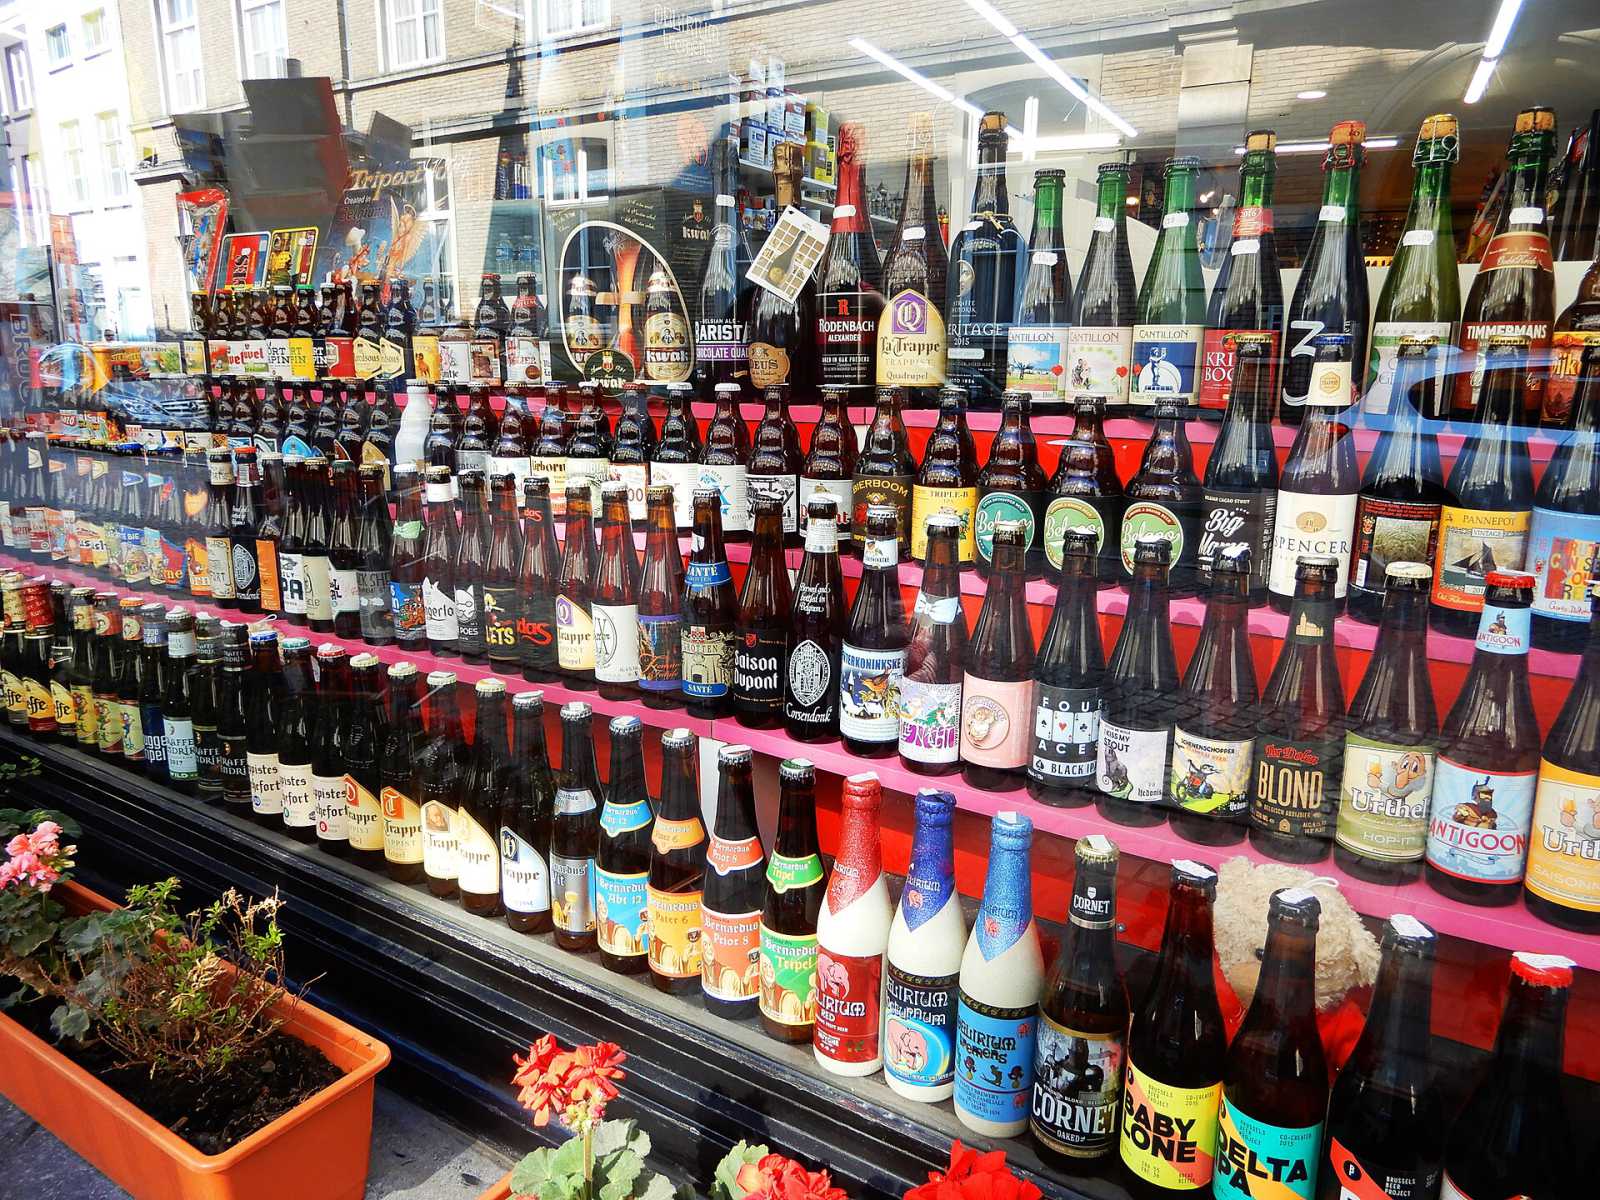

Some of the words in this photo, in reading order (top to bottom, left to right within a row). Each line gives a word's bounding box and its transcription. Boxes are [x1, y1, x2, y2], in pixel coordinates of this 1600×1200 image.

[837, 298, 850, 316] R
[818, 318, 875, 333] RODENBACH
[1139, 330, 1189, 339] CANTILLON
[954, 338, 970, 346] 2015
[852, 479, 908, 497] BIERBOOM
[1204, 508, 1245, 538] Big
[1463, 514, 1516, 526] PANNEPOT
[1275, 535, 1350, 554] SPENCER
[1478, 633, 1521, 648] ANTIGOON
[734, 650, 778, 672] Saison
[734, 669, 779, 692] Dupont
[786, 702, 833, 722] Corsendonk
[1103, 737, 1131, 754] STOUT
[1051, 762, 1083, 776] BLACK
[1257, 760, 1324, 809] BLOND
[1351, 787, 1429, 819] Urthel
[1430, 818, 1527, 854] ANTIGOON
[1072, 894, 1111, 915] CORNET
[820, 1008, 836, 1023] RED
[1033, 1081, 1120, 1135] CORNET
[1124, 1088, 1196, 1140] BABY
[1056, 1129, 1081, 1142] OAKED
[1123, 1109, 1198, 1164] LONE
[1217, 1119, 1309, 1183] DELTA
[1385, 1175, 1417, 1186] BRUSSELS
[1385, 1182, 1401, 1190] BEER
[1385, 1188, 1411, 1198] PROJECT
